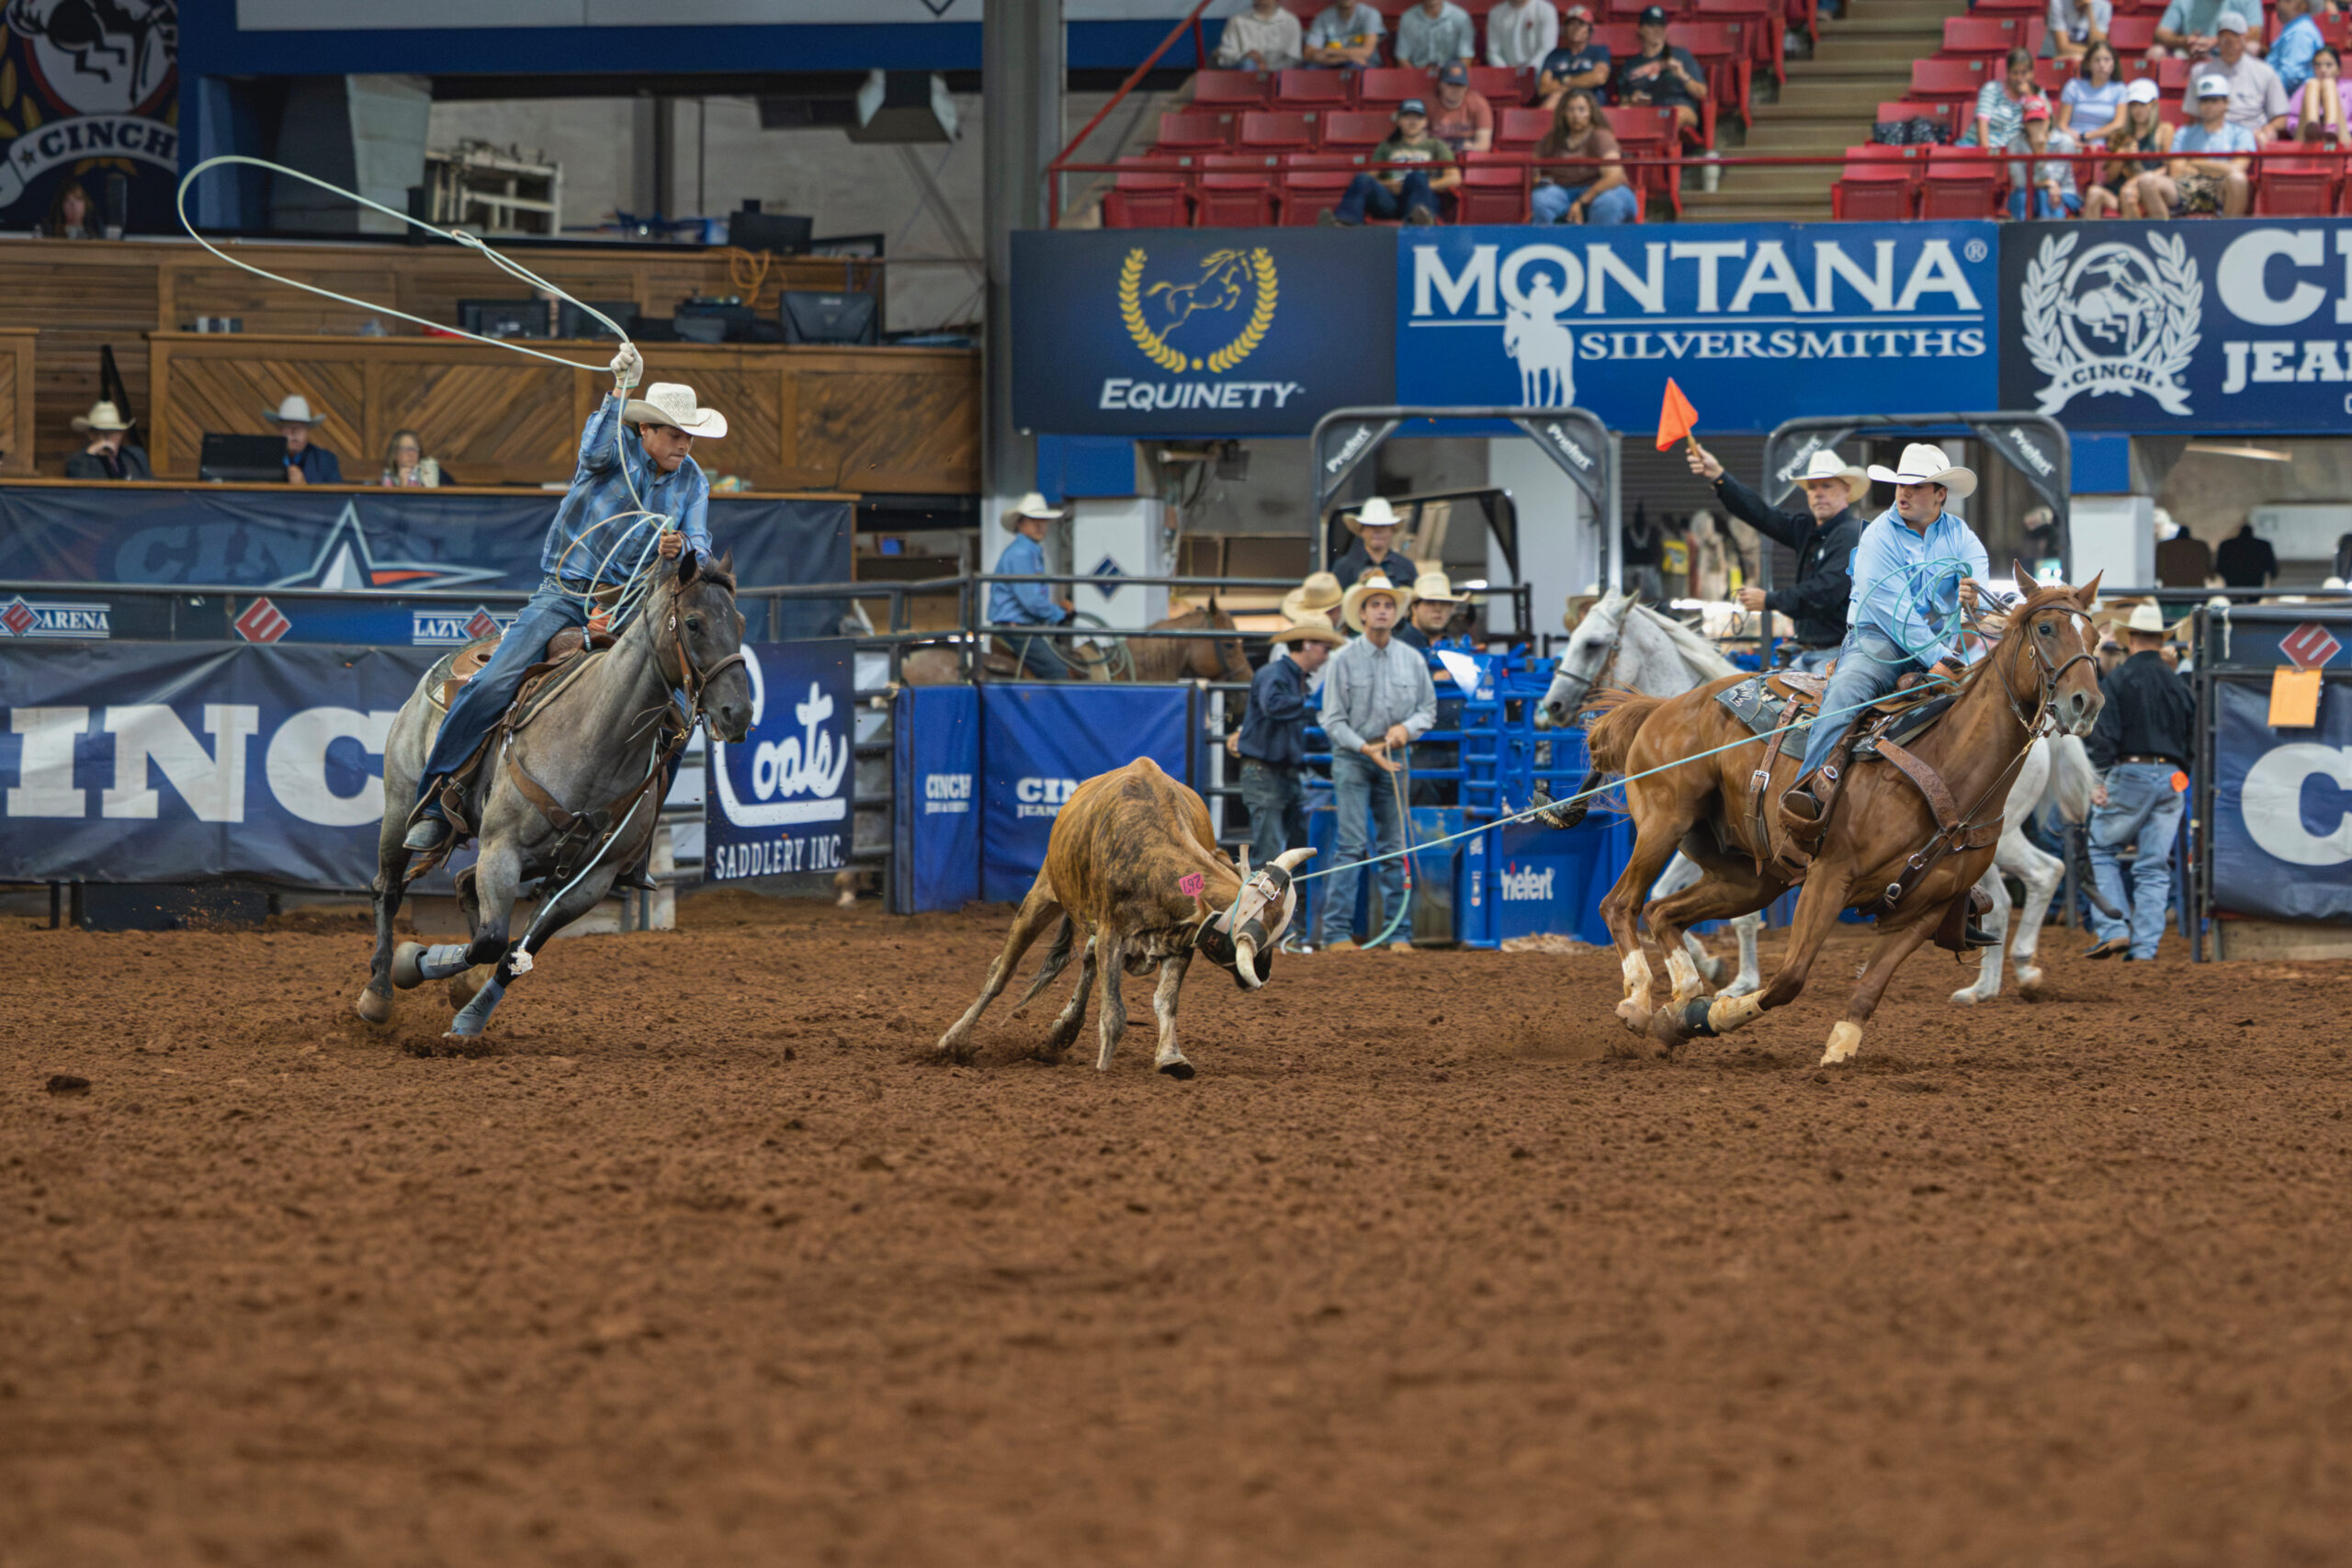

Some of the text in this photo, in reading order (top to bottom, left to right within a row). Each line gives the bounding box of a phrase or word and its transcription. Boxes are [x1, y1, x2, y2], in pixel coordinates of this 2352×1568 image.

[38, 119, 175, 159] CINCH
[1578, 327, 1986, 359] SILVERSMITHS
[2072, 364, 2154, 384] CINCH
[2222, 340, 2352, 394] JEA
[40, 611, 109, 629] ARENA
[413, 619, 462, 637] LAZY
[925, 773, 972, 799] CINCH
[716, 834, 846, 880] SADDLERY INC.
